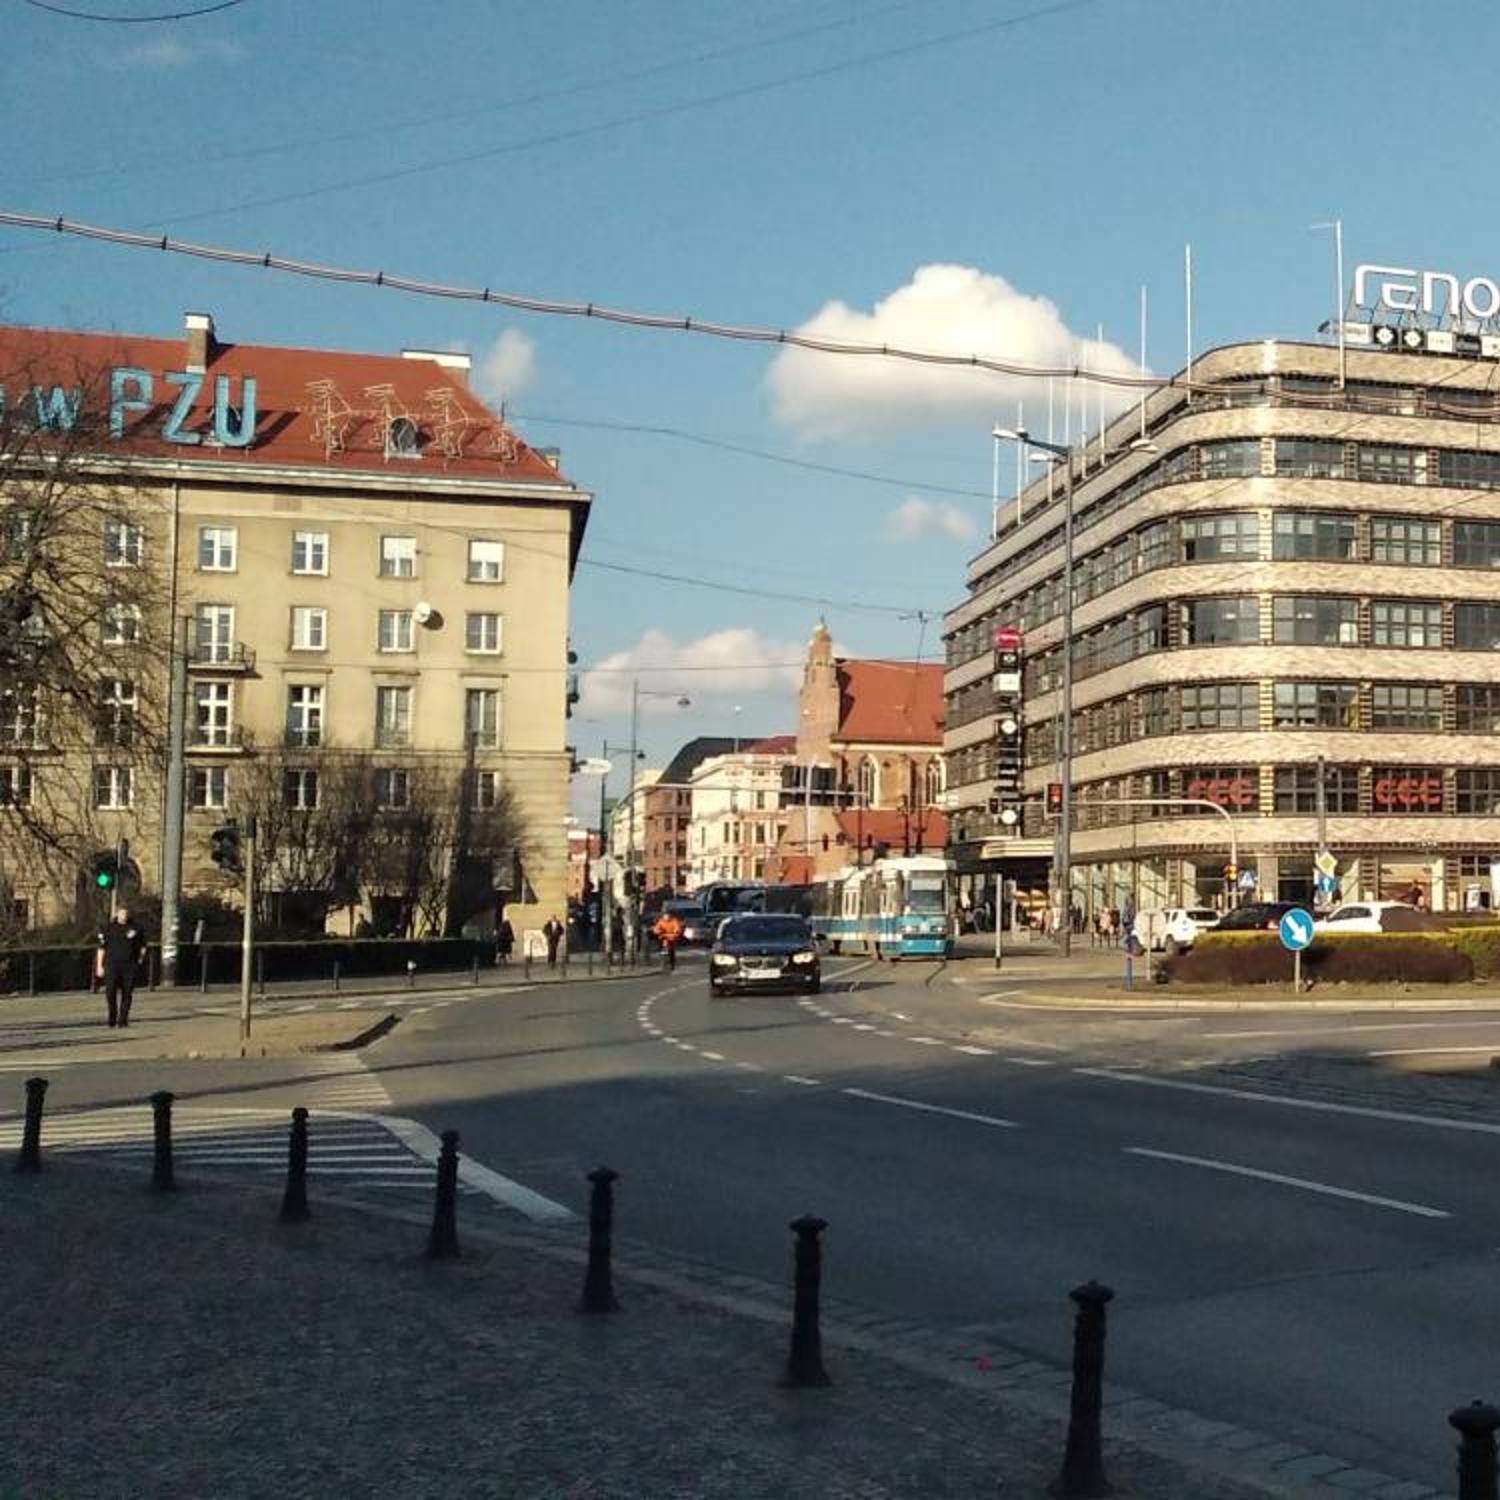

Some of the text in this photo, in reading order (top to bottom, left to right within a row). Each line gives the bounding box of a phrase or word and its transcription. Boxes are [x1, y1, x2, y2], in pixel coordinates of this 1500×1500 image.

[109, 366, 257, 448] PZU
[1189, 779, 1252, 805] CCC
[1375, 779, 1441, 805] CCC
